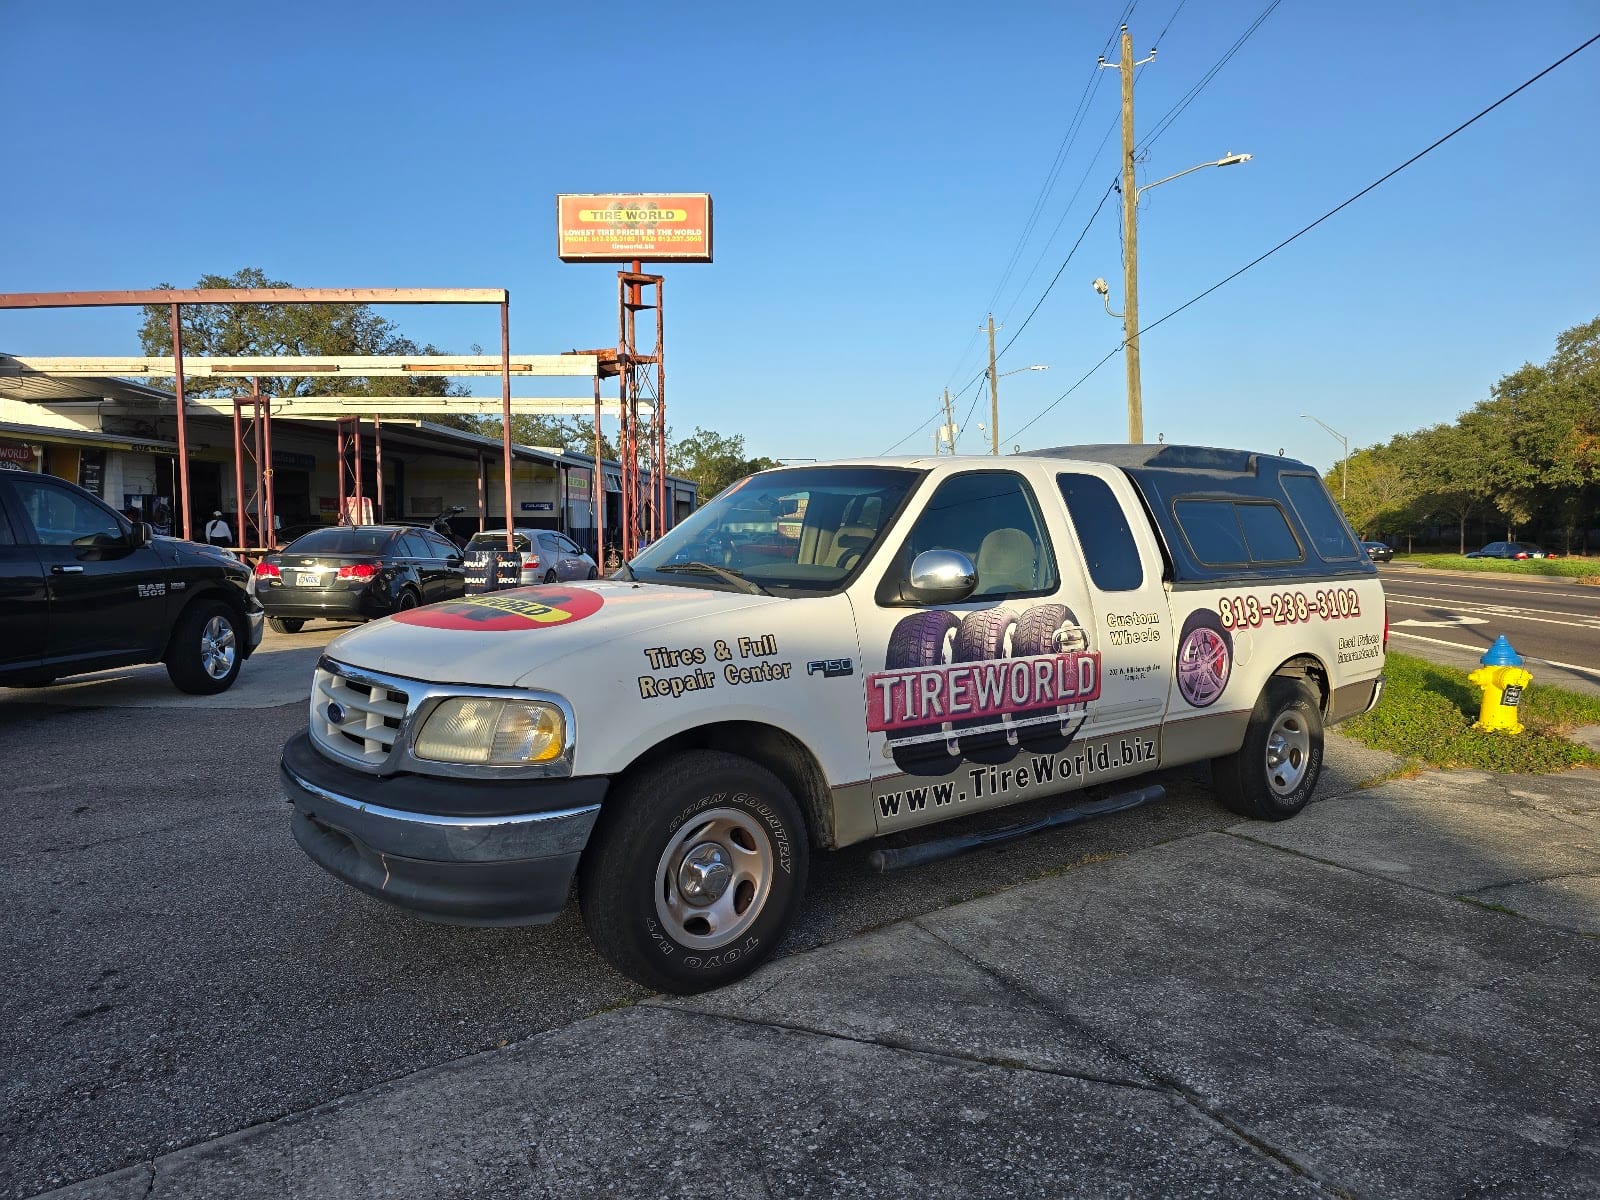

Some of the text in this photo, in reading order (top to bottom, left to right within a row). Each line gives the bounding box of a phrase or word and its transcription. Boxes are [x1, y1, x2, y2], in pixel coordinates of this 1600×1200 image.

[591, 211, 675, 220] TIRE WORLD
[138, 583, 166, 591] RAM
[1106, 611, 1160, 628] Custom
[1219, 589, 1362, 631] 813-238-3102
[644, 633, 778, 670] Tires & Full
[1109, 627, 1161, 645] Wheels
[1338, 633, 1380, 650] Best Prices
[638, 661, 792, 700] Repair Center
[873, 656, 1097, 725] TIREWORLD
[669, 792, 791, 875] OPEN COUNTRY
[683, 936, 760, 969] TOYO
